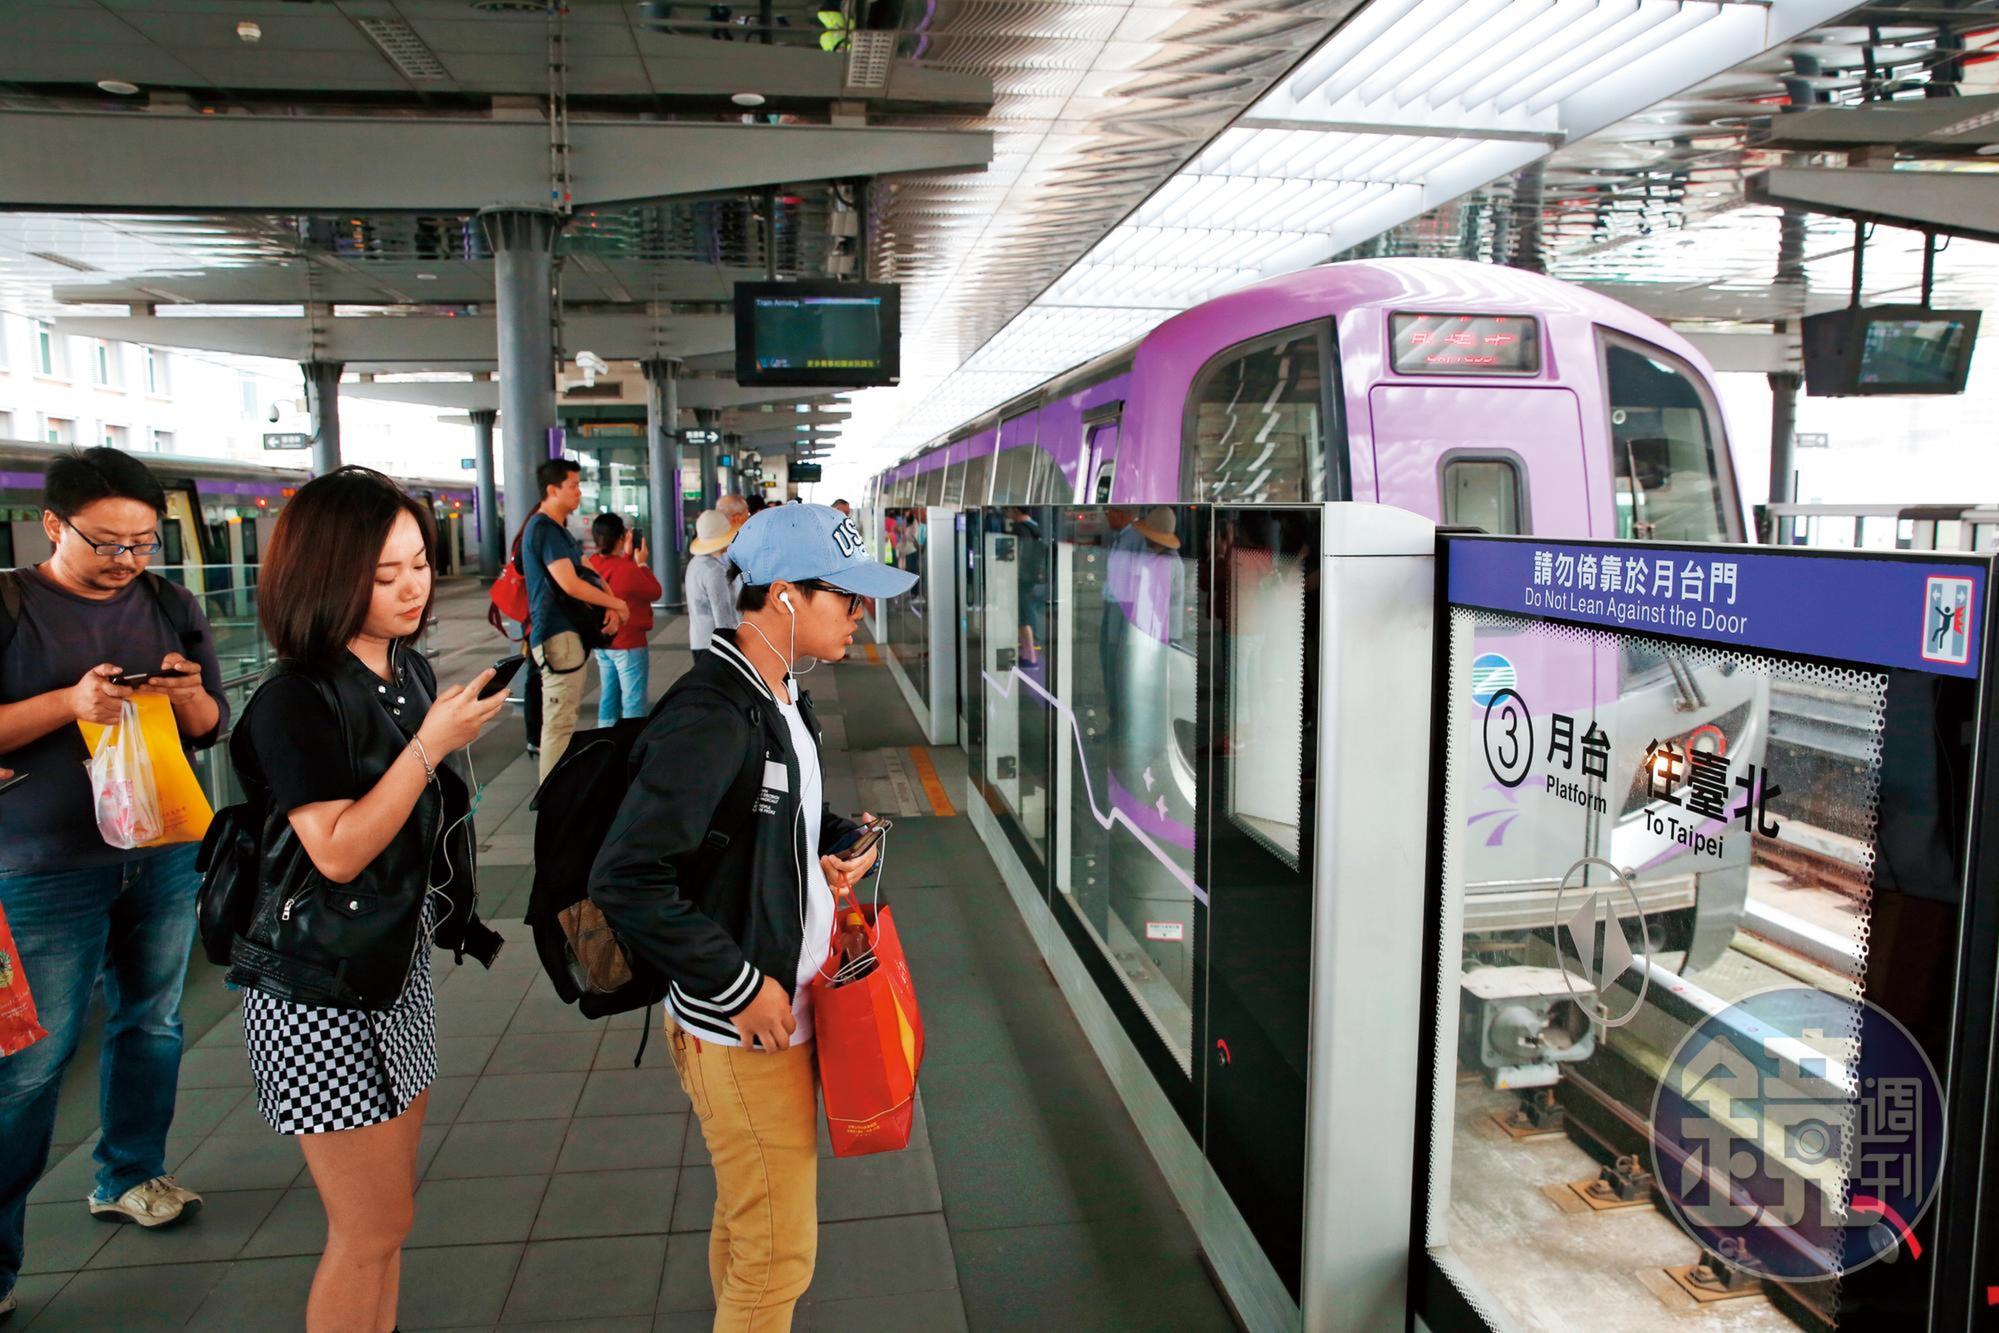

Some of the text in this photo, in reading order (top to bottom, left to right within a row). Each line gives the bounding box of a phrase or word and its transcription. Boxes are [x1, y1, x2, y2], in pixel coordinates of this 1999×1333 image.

[1533, 551, 1739, 605] 請勿倚靠於月台門
[1525, 587, 1748, 634] Do Not Lean Against the Door
[1547, 713, 1611, 782] 月台
[1546, 774, 1607, 814] Platform
[1645, 738, 1781, 839] 往臺北
[1644, 808, 1723, 859] To Taipei
